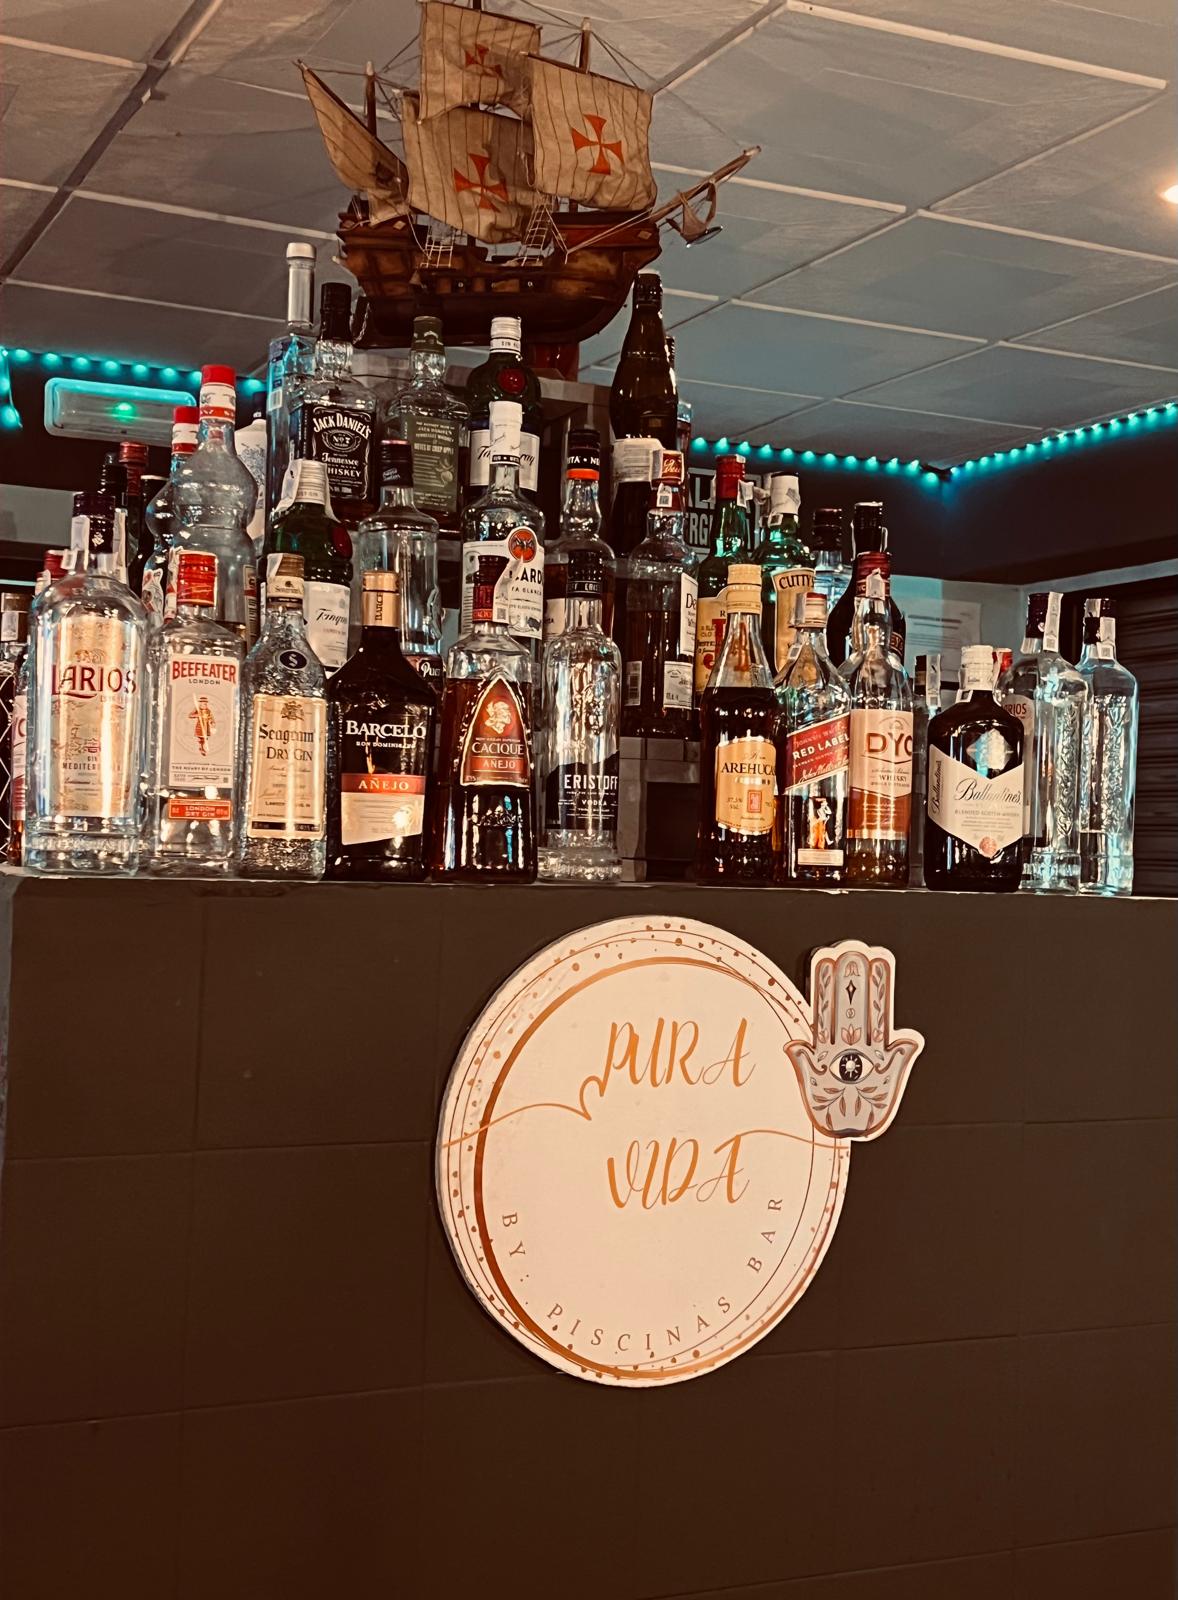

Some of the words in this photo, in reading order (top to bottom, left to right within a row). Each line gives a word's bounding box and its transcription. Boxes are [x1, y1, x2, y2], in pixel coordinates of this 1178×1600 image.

[312, 416, 337, 433] JACK
[335, 412, 372, 440] DANIEL'S
[327, 466, 362, 478] HISKEY
[779, 574, 810, 590] CUTTY
[51, 664, 137, 697] LARIOS
[172, 660, 237, 684] BEEFEATER
[345, 720, 427, 739] BARCELÓ
[471, 742, 525, 756] CACIQUE
[792, 746, 816, 760] RED
[817, 732, 850, 752] LABEL
[482, 759, 517, 770] AÑEJO
[358, 777, 410, 791] AÑEJO
[564, 774, 619, 791] ERISTOFF
[599, 1016, 757, 1098] PURA
[606, 1136, 750, 1211] VIDA
[546, 1294, 732, 1352] PISCINAS
[746, 1197, 784, 1274] BAR
